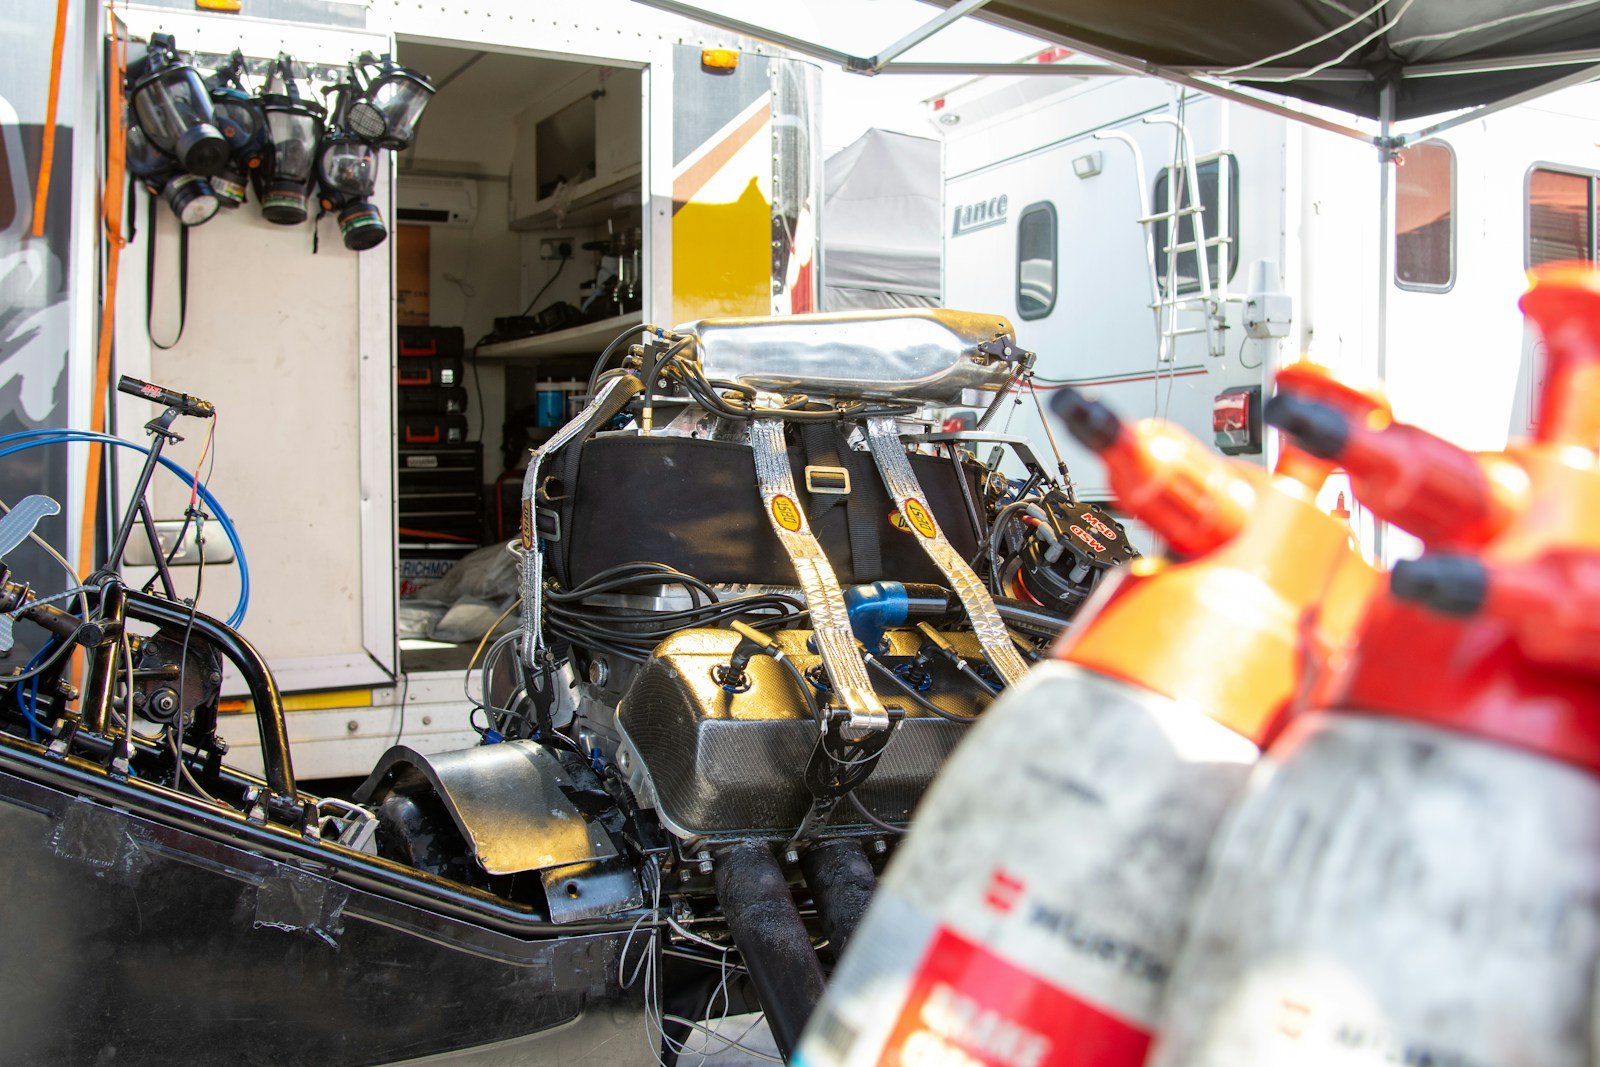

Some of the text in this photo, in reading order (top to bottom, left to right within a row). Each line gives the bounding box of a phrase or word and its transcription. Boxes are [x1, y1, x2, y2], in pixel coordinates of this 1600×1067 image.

[951, 194, 1008, 238] Lance
[1069, 524, 1107, 553] MSD
[1080, 512, 1118, 541] MSD
